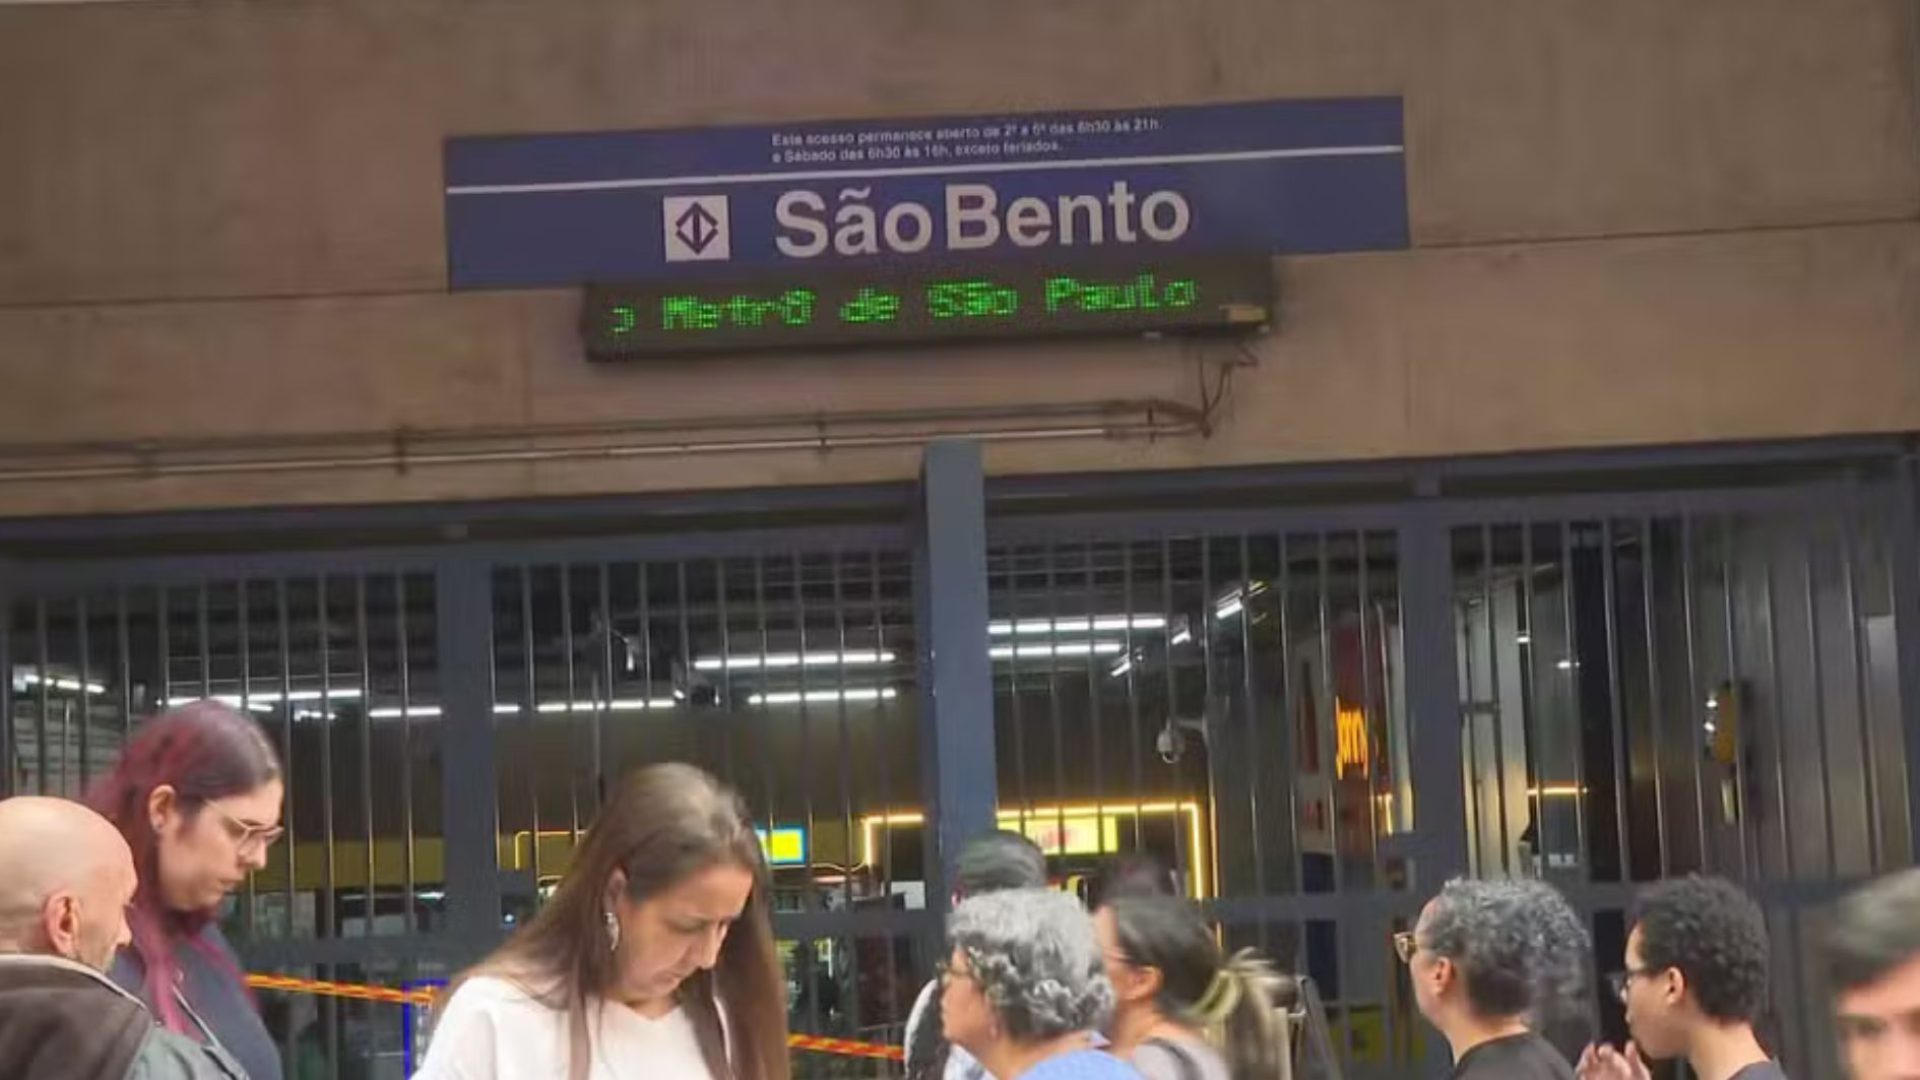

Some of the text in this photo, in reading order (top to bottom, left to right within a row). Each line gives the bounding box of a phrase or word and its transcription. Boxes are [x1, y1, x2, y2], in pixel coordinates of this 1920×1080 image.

[772, 133, 803, 146] Este
[805, 132, 855, 145] acesso
[857, 129, 933, 146] permanece
[936, 126, 981, 140] aberto
[983, 125, 1000, 138] de
[1049, 121, 1074, 134] das
[772, 152, 782, 163] e
[839, 148, 864, 161] das
[867, 145, 900, 160] 6h30
[955, 141, 1000, 155] exceto
[775, 180, 1191, 258] São Bento
[840, 288, 900, 322] de
[1045, 274, 1196, 311] Paulo
